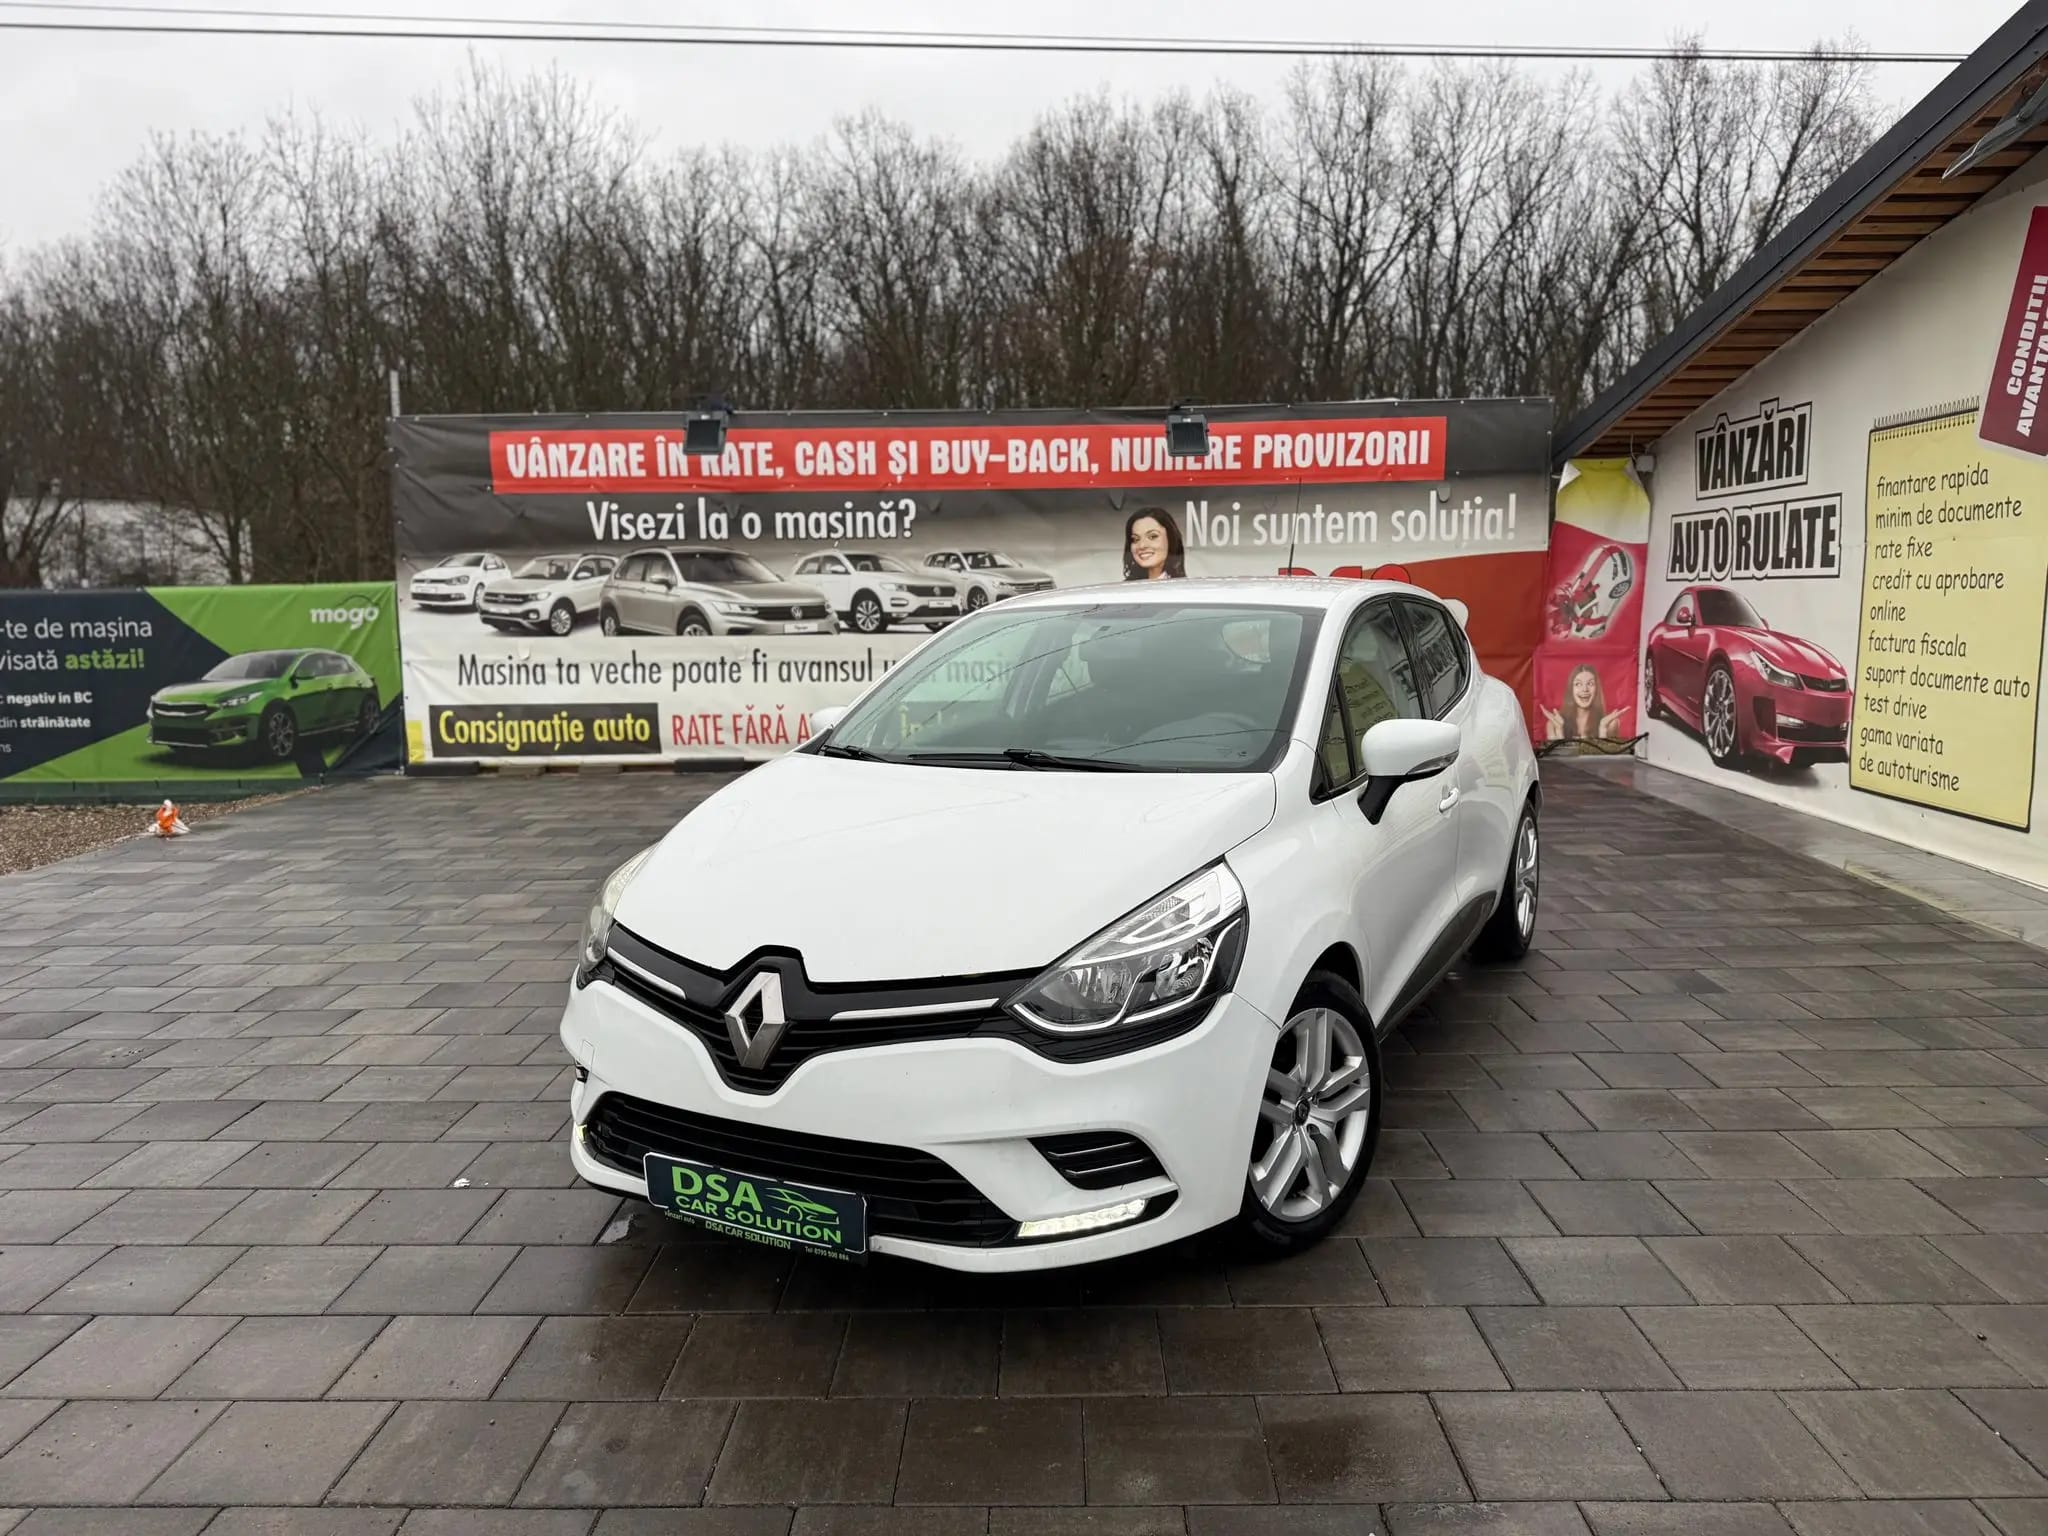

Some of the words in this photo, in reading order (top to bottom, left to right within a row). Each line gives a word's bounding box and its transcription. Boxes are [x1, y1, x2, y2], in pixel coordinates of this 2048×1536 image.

[506, 435, 647, 478] VÂNZARE
[654, 435, 689, 477] ÎN
[795, 440, 877, 477] CASH
[887, 439, 919, 484] ȘI
[929, 437, 1100, 475] BUY-BACK,
[1252, 429, 1431, 470] PROVIZORII
[1698, 407, 1807, 492] VÂNZĂRI
[1876, 475, 1936, 499] finantare
[1941, 461, 1989, 495] rapida
[586, 500, 686, 540] Visezi
[697, 496, 729, 540] la
[741, 511, 762, 540] o
[1186, 500, 1241, 547] Noi
[1253, 503, 1379, 545] suntem
[1875, 507, 1912, 529] minim
[1916, 502, 1933, 525] de
[1938, 496, 2022, 524] documente
[1670, 516, 1729, 574] AUTO
[1735, 504, 1837, 571] RULATE
[1874, 540, 1902, 559] rate
[1907, 535, 1933, 559] fixe
[1872, 568, 1912, 590] credit
[1916, 574, 1931, 590] cu
[1935, 566, 2004, 597] aprobare
[310, 606, 379, 630] mogo
[1870, 599, 1906, 622] online
[34, 617, 63, 638] de
[70, 616, 152, 643] mașina
[1868, 630, 1915, 654] factura
[1920, 631, 1967, 657] fiscala
[65, 648, 145, 670] astăzi!
[555, 656, 580, 685] ta
[591, 650, 661, 684] veche
[672, 655, 742, 692] poate
[752, 648, 768, 683] fi
[778, 647, 873, 684] avansul
[1865, 665, 1906, 688] suport
[1910, 664, 1989, 694] documente
[1994, 675, 2030, 698] auto
[6, 691, 56, 707] negativ
[74, 691, 93, 704] BC
[1864, 693, 1889, 715] test
[1893, 694, 1927, 720] drive
[0, 715, 17, 728] din
[20, 715, 91, 729] străinătate
[439, 710, 584, 752] Consignație
[593, 712, 650, 742] auto
[671, 714, 724, 746] RATE
[732, 704, 789, 745] FĂRĂ
[1860, 726, 1892, 747] gama
[1896, 730, 1944, 755] variata
[1859, 751, 1874, 773] de
[1877, 758, 1960, 792] autoturisme
[671, 1165, 763, 1213] DSA
[675, 1194, 718, 1217] CAR
[724, 1206, 842, 1245] SOLUTION
[705, 1220, 724, 1233] DSA
[725, 1226, 744, 1239] CAR
[744, 1231, 792, 1250] SOLUTION
